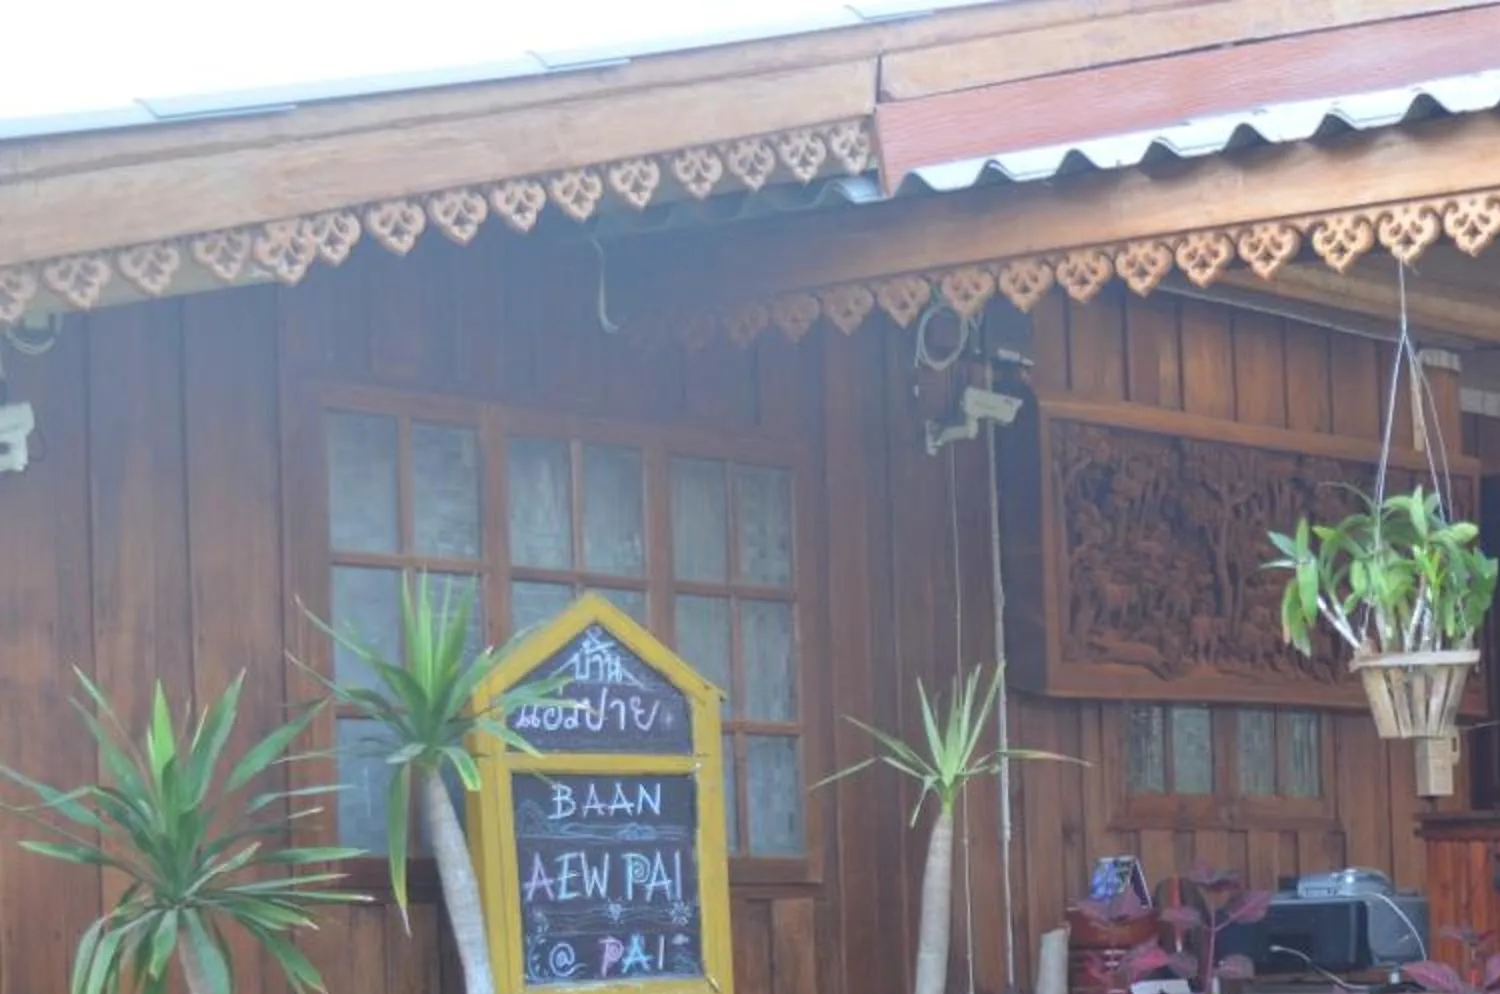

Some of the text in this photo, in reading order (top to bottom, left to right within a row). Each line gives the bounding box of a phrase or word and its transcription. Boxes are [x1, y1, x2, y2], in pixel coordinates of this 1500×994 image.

[573, 625, 623, 683] บ้าน
[547, 782, 662, 820] BAAN
[523, 851, 683, 902] AEW PAI
[549, 932, 664, 978] @ PAI
